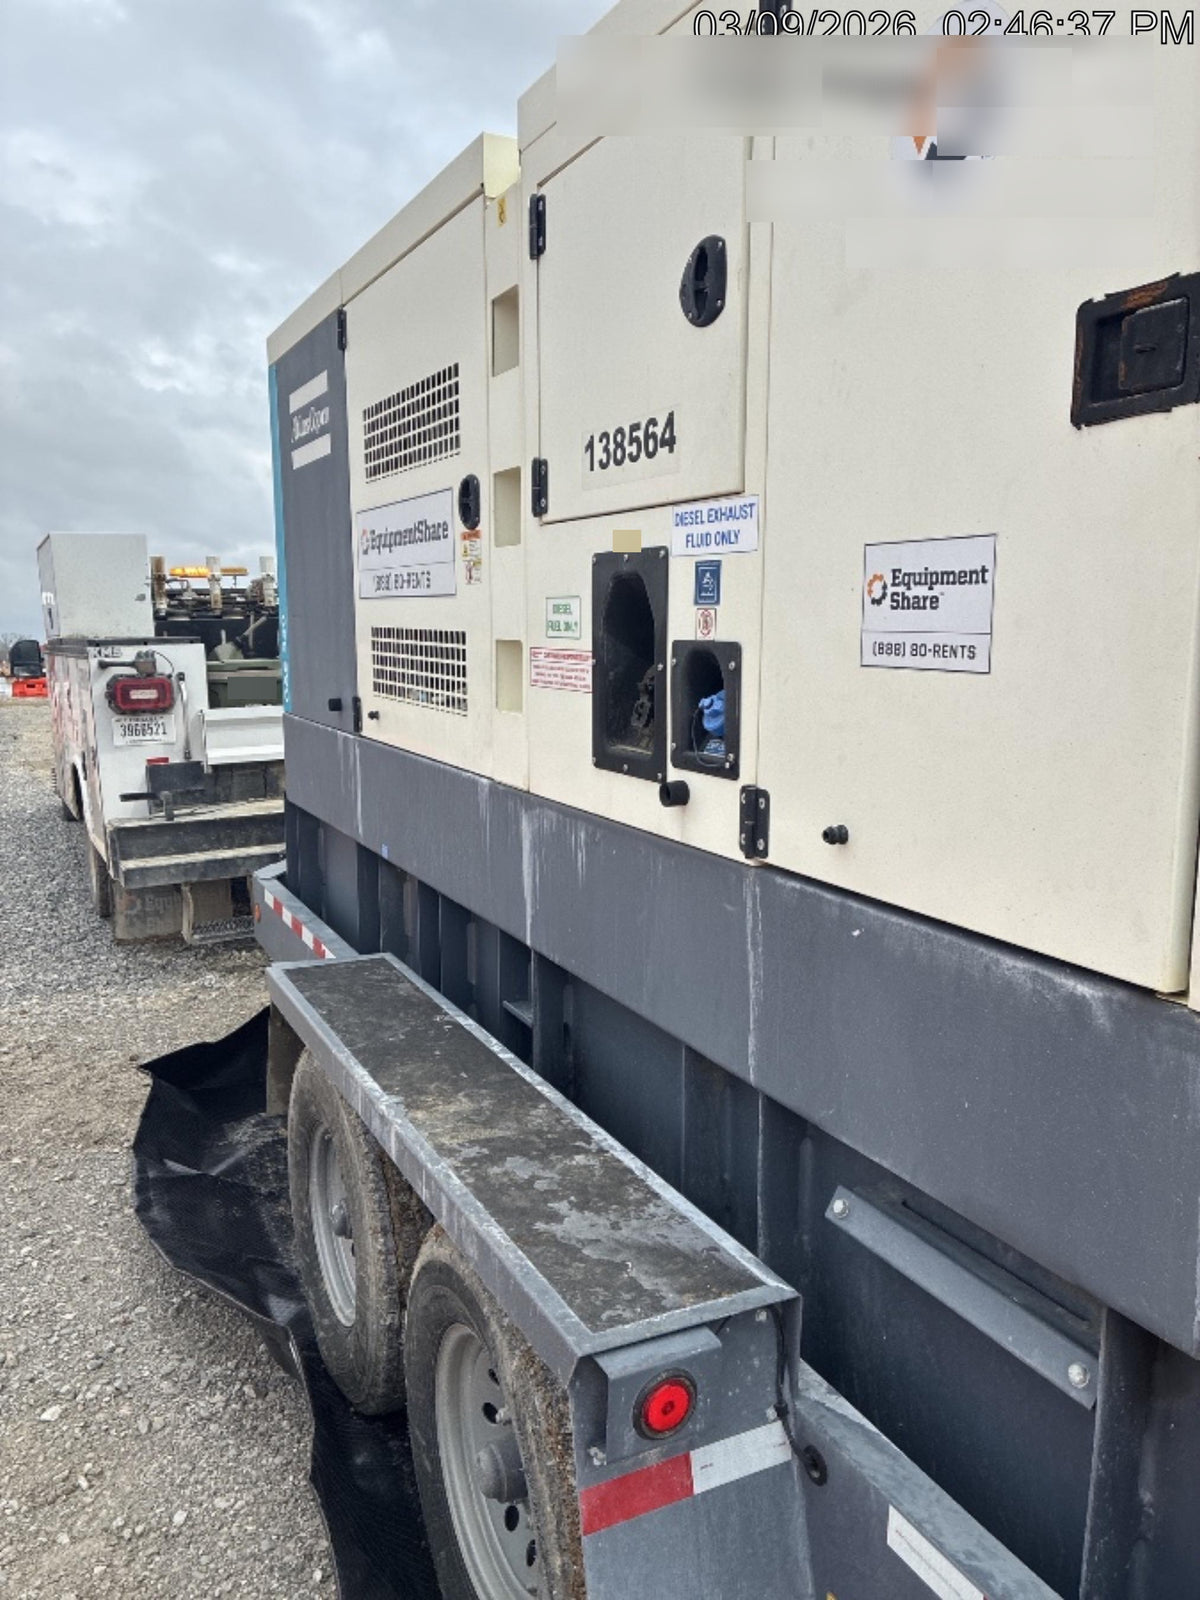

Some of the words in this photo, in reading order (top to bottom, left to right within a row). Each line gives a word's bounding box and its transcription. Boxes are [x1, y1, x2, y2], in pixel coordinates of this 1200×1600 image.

[584, 410, 677, 472] 138564
[675, 509, 705, 527] DIESEL
[707, 502, 756, 524] EXHAUST
[685, 532, 712, 549] FLUID
[714, 529, 741, 547] ONLY
[890, 565, 989, 591] Equipment
[890, 591, 940, 611] Share
[872, 640, 906, 657] (888)
[910, 642, 977, 660] 80-RENTS
